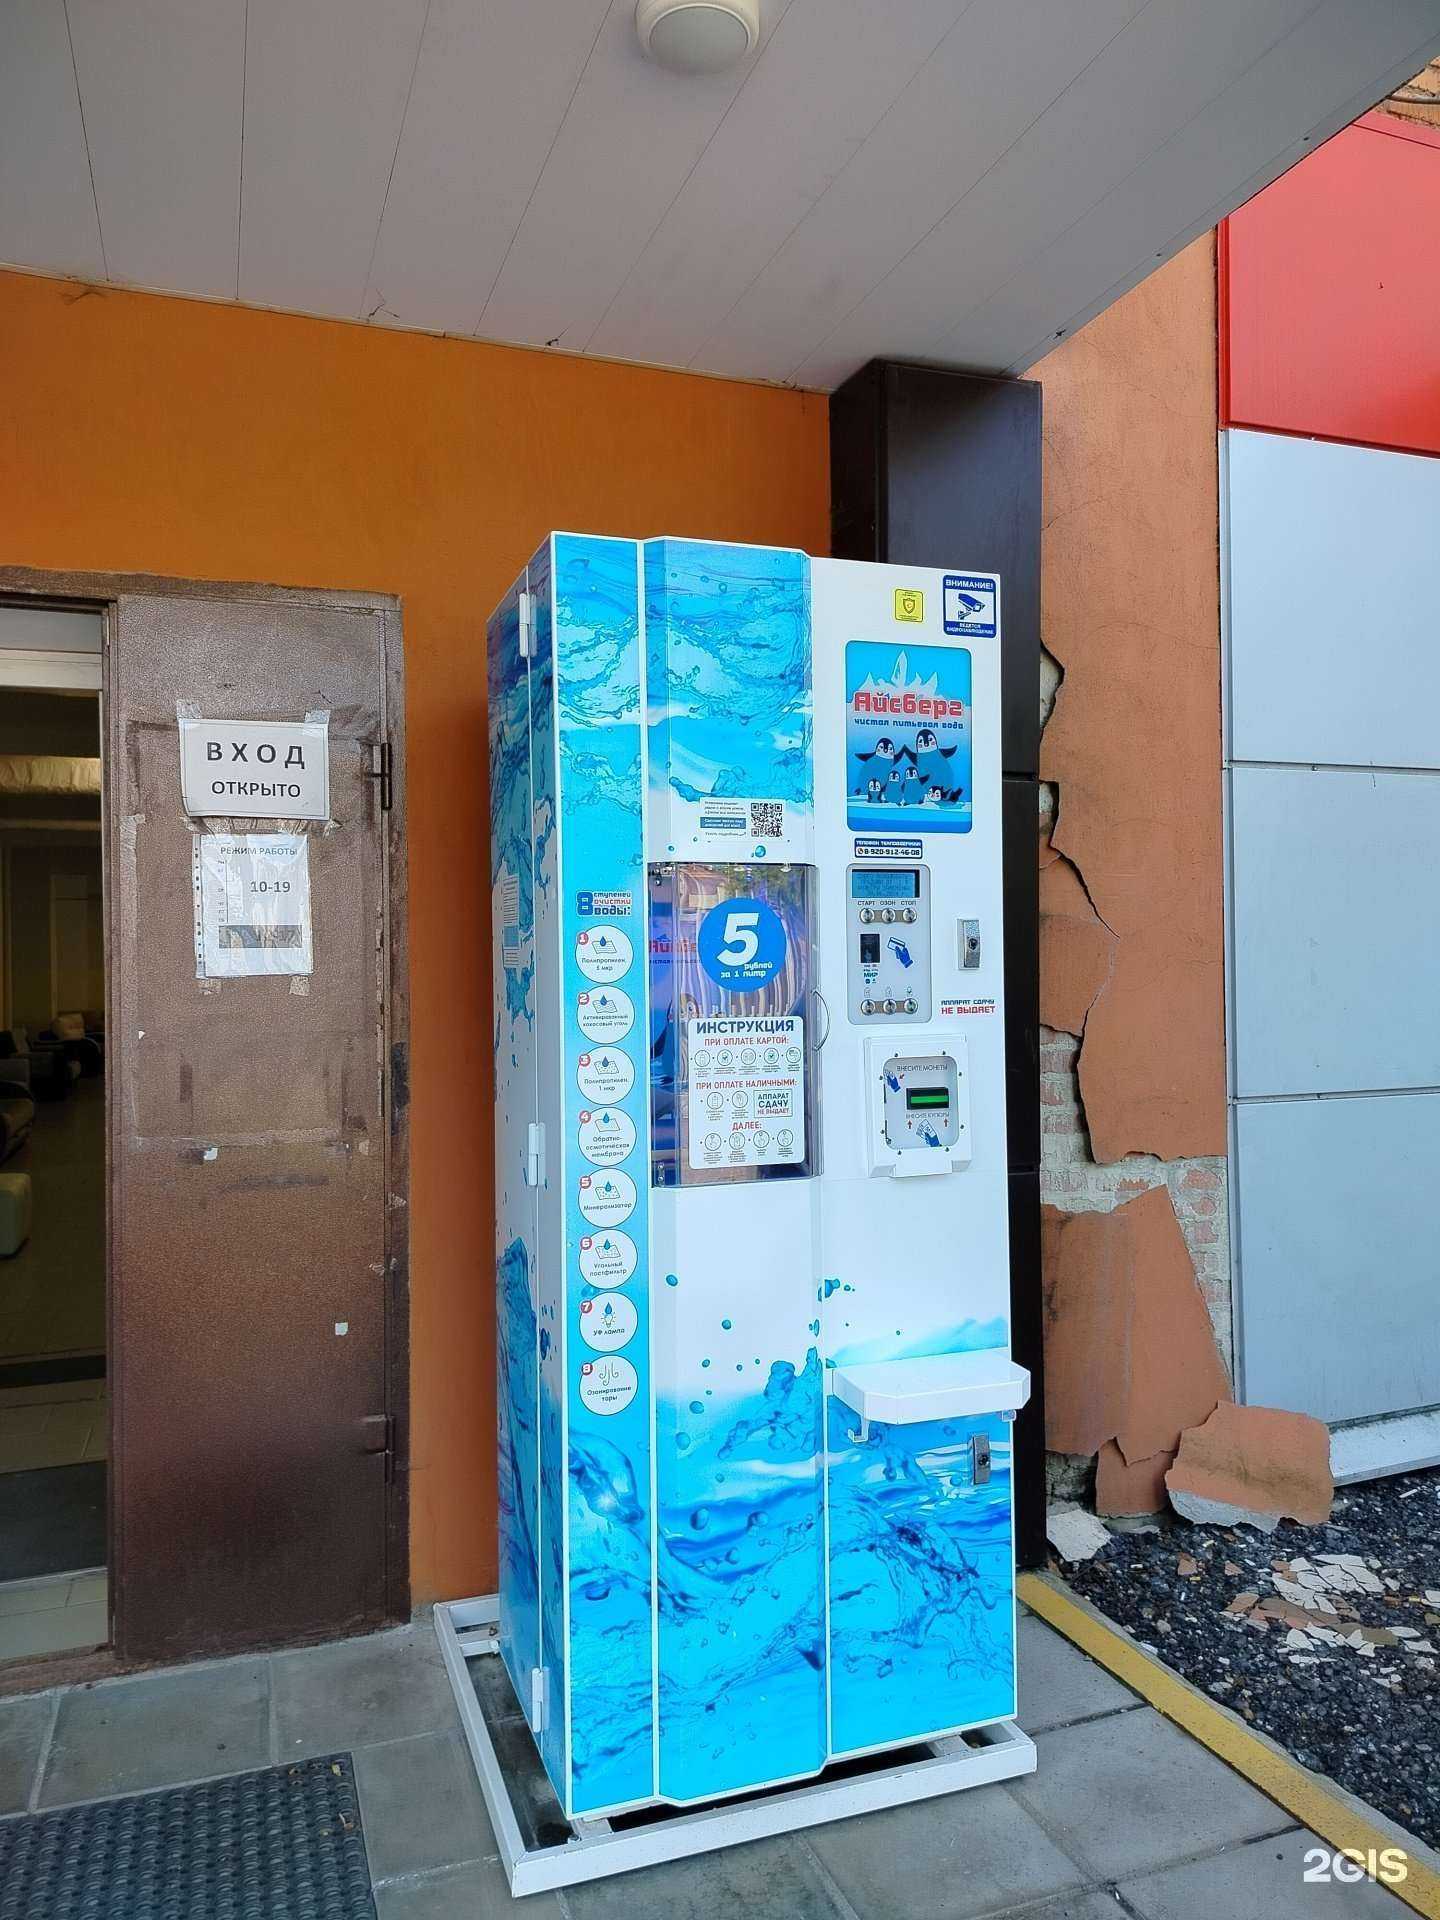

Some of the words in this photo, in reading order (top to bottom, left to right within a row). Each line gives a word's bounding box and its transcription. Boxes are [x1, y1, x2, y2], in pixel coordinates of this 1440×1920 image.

[945, 579, 993, 590] ВНИМАНИЕ!
[854, 692, 962, 719] Айсберг
[855, 718, 889, 726] чистая
[892, 720, 938, 729] питьевая
[211, 781, 301, 798] ОТКРЫТО
[220, 847, 257, 855] РЕЖИМ
[864, 848, 920, 856] 8-920-912-46-08
[250, 881, 291, 892] 10-19
[577, 892, 593, 915] 8
[594, 905, 631, 915] воды:
[716, 912, 760, 967] 5
[744, 962, 773, 972] рублей
[743, 970, 767, 979] литр
[941, 1007, 954, 1015] НЕ
[957, 1006, 996, 1014] ВЫДАЕТ
[696, 1020, 794, 1034] ИНСТРУКЦИЯ
[704, 1038, 721, 1046] ПРИ
[723, 1037, 754, 1046] ОПЛАТЕ
[756, 1036, 790, 1045] КАРТОЙ:
[696, 1082, 711, 1090] ПРИ
[714, 1081, 744, 1089] ОПЛАТЕ
[745, 1079, 798, 1088] НАЛИЧНЫМИ:
[758, 1100, 789, 1108] СДАЧУ
[732, 1121, 762, 1131] ДАЛЕЕ:
